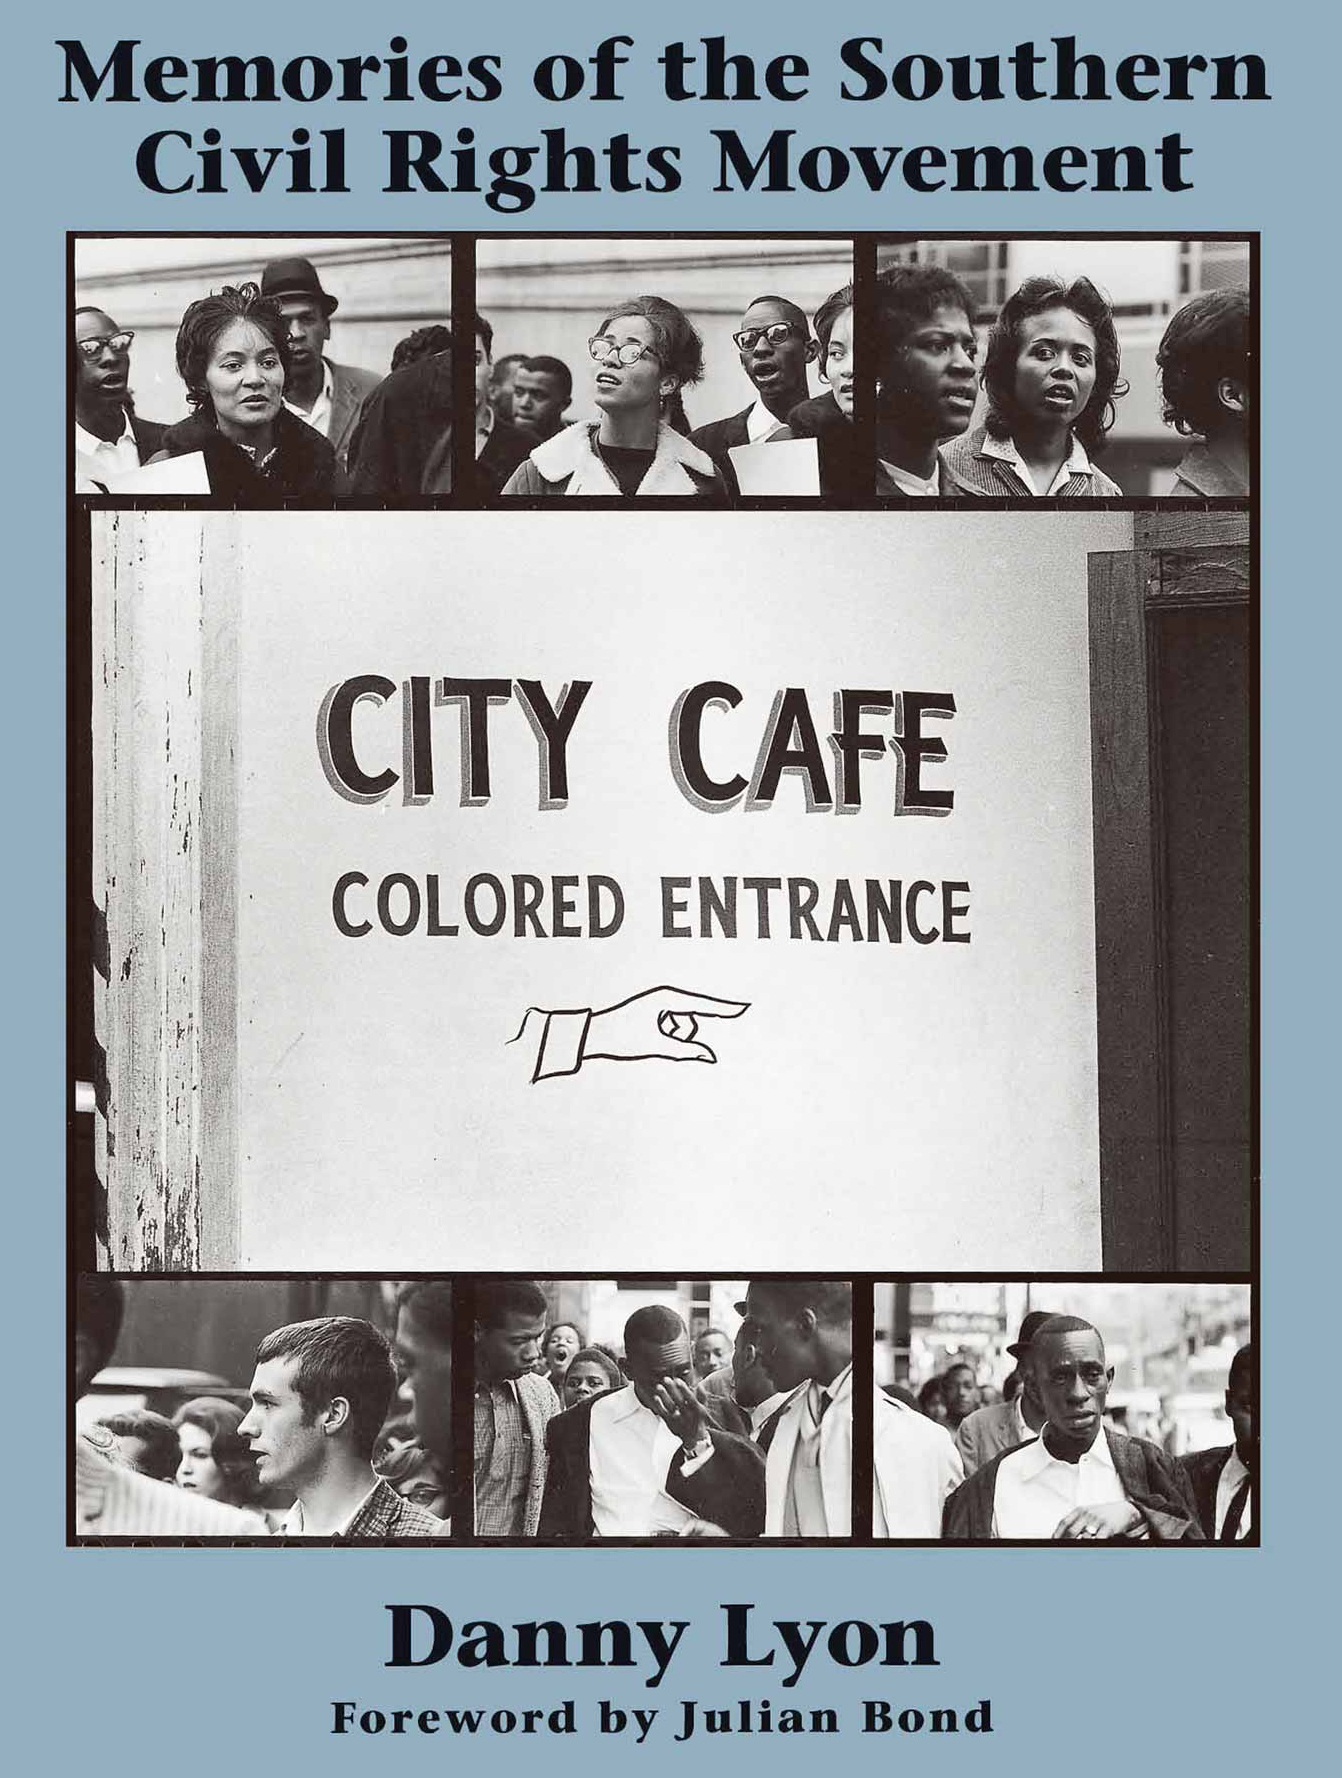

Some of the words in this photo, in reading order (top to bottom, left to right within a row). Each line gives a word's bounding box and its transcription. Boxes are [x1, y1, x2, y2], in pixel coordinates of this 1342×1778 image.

[56, 37, 502, 103] Memories
[533, 36, 635, 102] of
[658, 36, 810, 102] the
[840, 36, 1272, 101] Southern
[135, 128, 351, 194] Civil
[382, 128, 682, 214] Rights
[709, 129, 1194, 193] Movement
[316, 675, 593, 811] CITY
[668, 680, 958, 817] CAFE
[332, 871, 625, 939] COLORED
[660, 875, 972, 945] ENTRANCE
[384, 1604, 691, 1688] Danny
[719, 1604, 941, 1688] Lyon
[330, 1701, 577, 1734] Foreword
[598, 1701, 659, 1744] by
[674, 1700, 840, 1742] Julian
[862, 1700, 994, 1733] Bond
